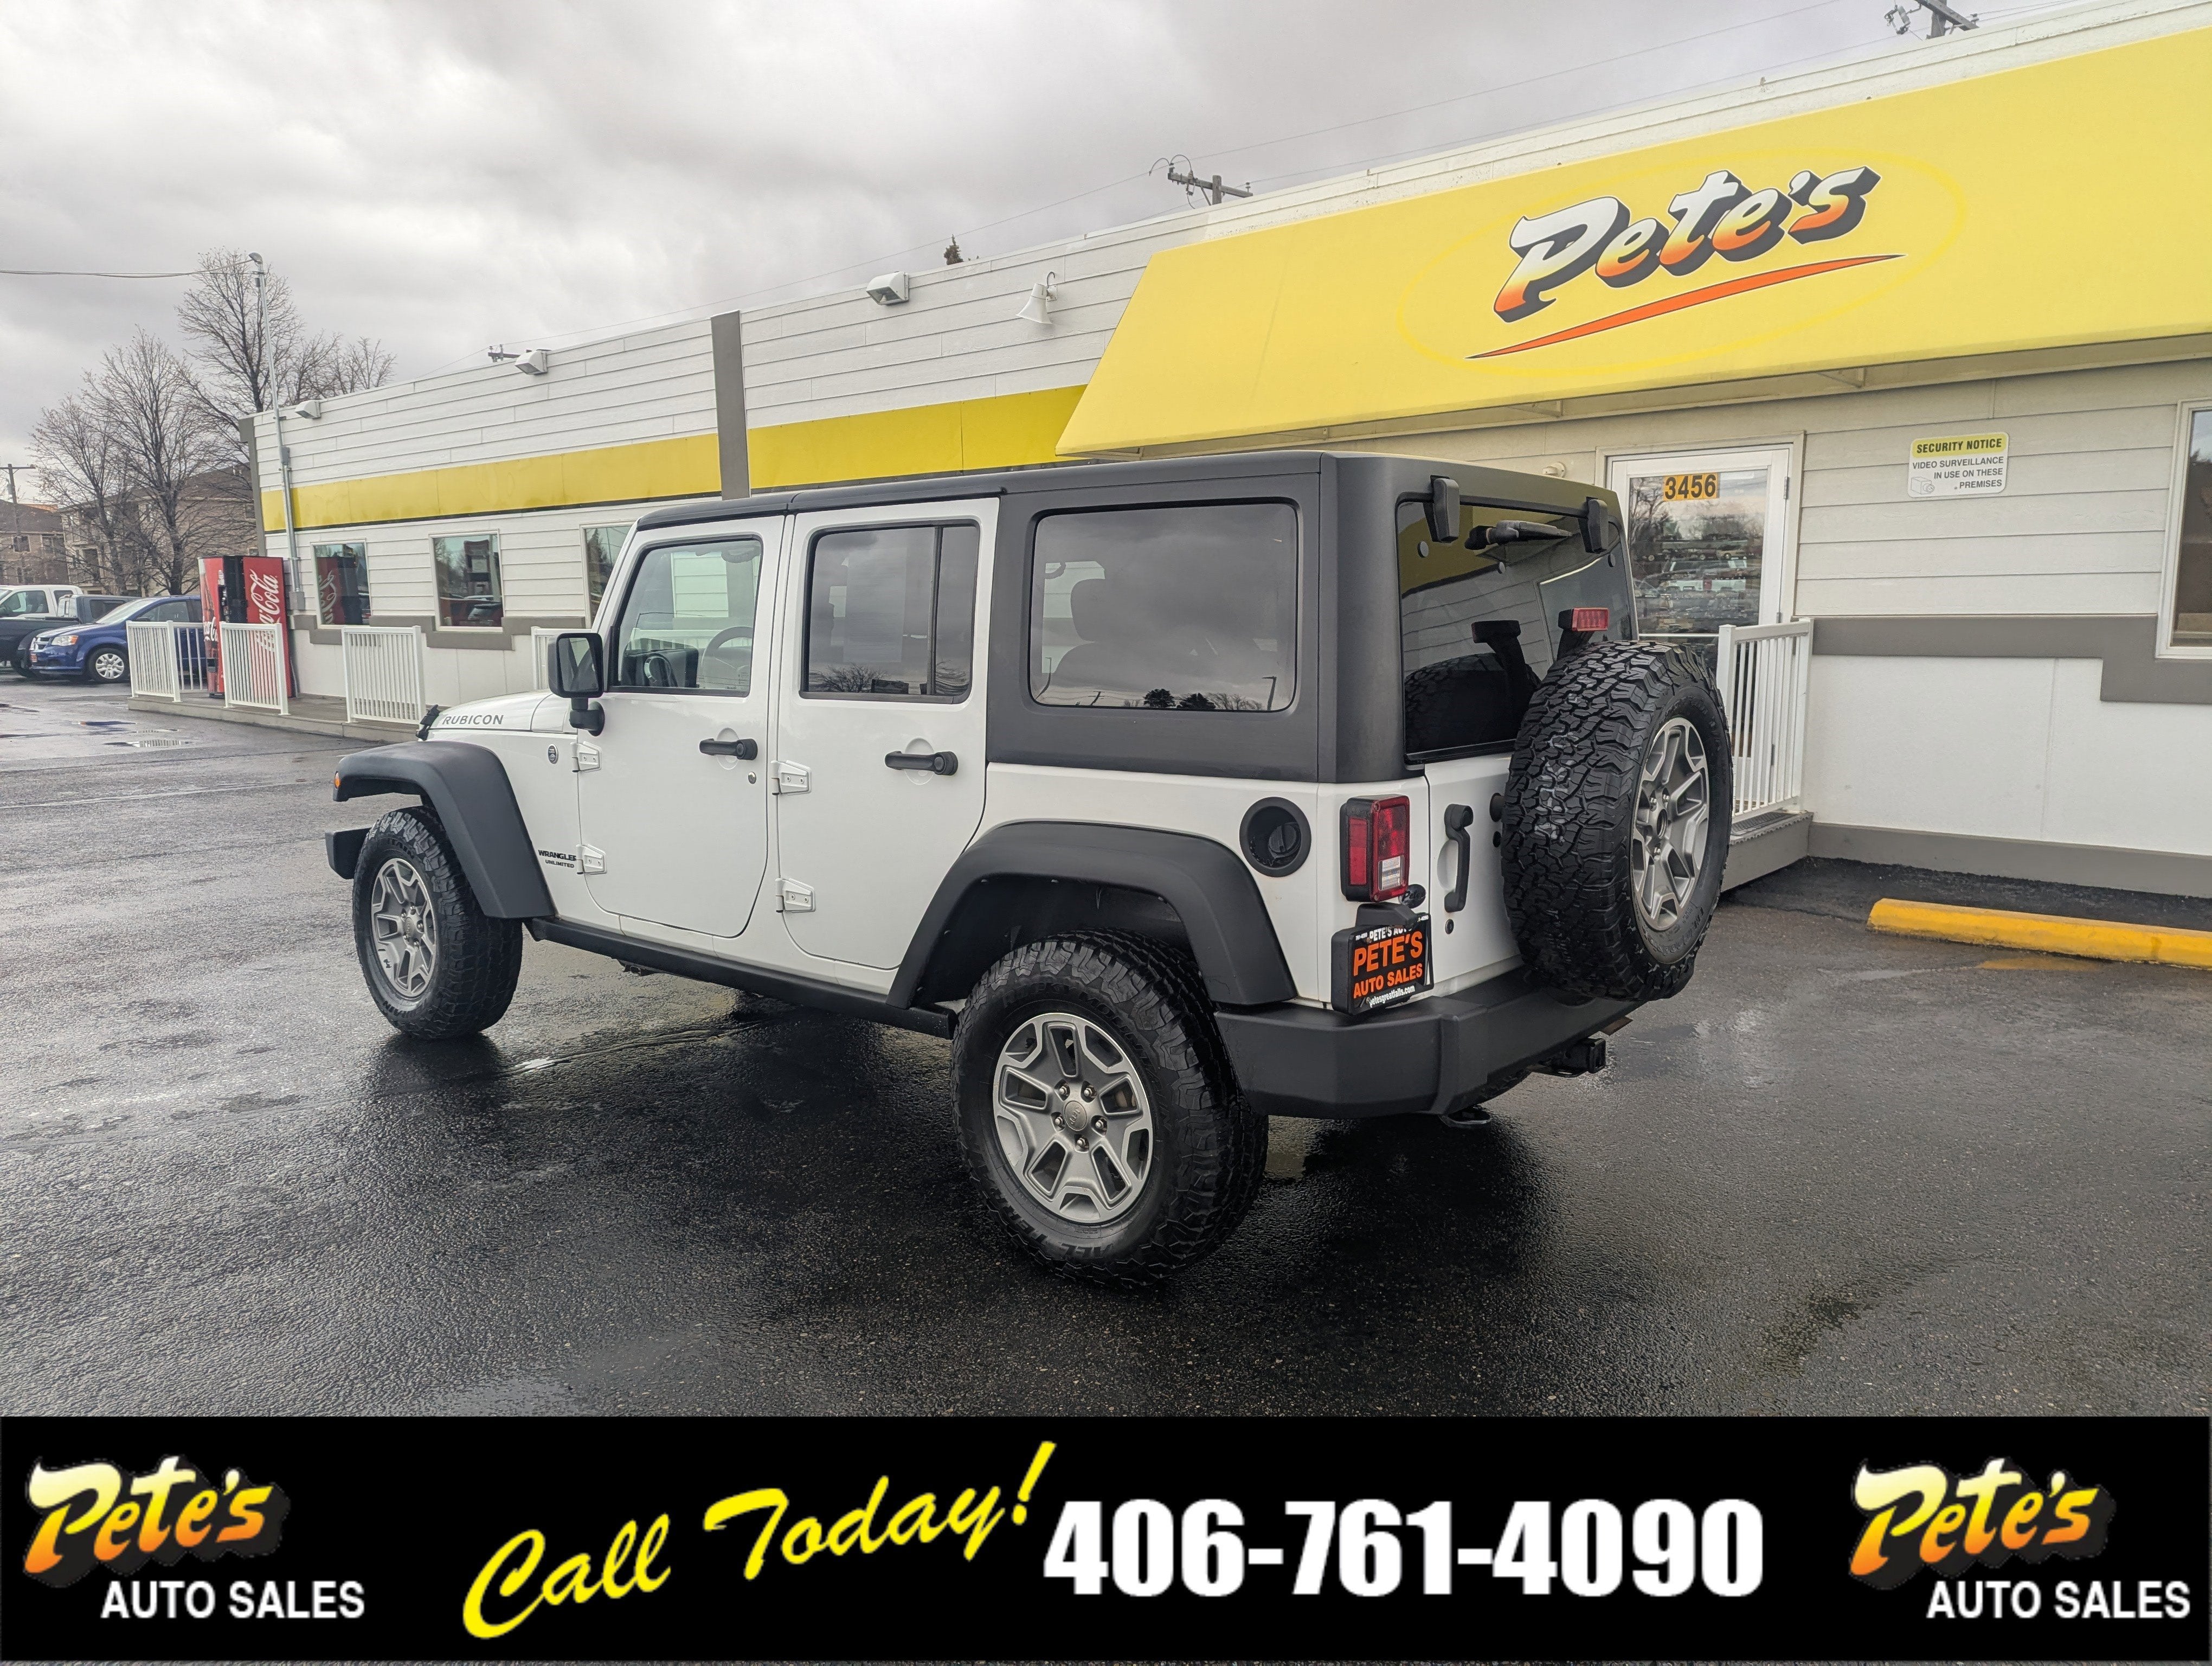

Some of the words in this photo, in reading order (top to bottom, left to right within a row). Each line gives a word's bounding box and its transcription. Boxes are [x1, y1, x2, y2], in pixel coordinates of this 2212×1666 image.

[1494, 165, 1881, 323] Pete's
[1917, 441, 1964, 454] SECURITY
[1966, 438, 2002, 450] NOTICE
[1913, 460, 1937, 469] VIDEO
[1939, 456, 2004, 467] SURVEILLANCE
[1944, 470, 1960, 478] USE
[1976, 467, 2003, 476] THESE
[1664, 473, 1716, 499] 3456
[1959, 479, 2002, 489] PREMISES
[442, 714, 504, 726] RUBICON
[545, 859, 575, 868] UNLIMITED
[1353, 931, 1423, 976] PETE'S
[1353, 975, 1384, 999] AUTO
[1387, 963, 1423, 986] SALES
[1368, 985, 1416, 1008] petesgreatfalls.com
